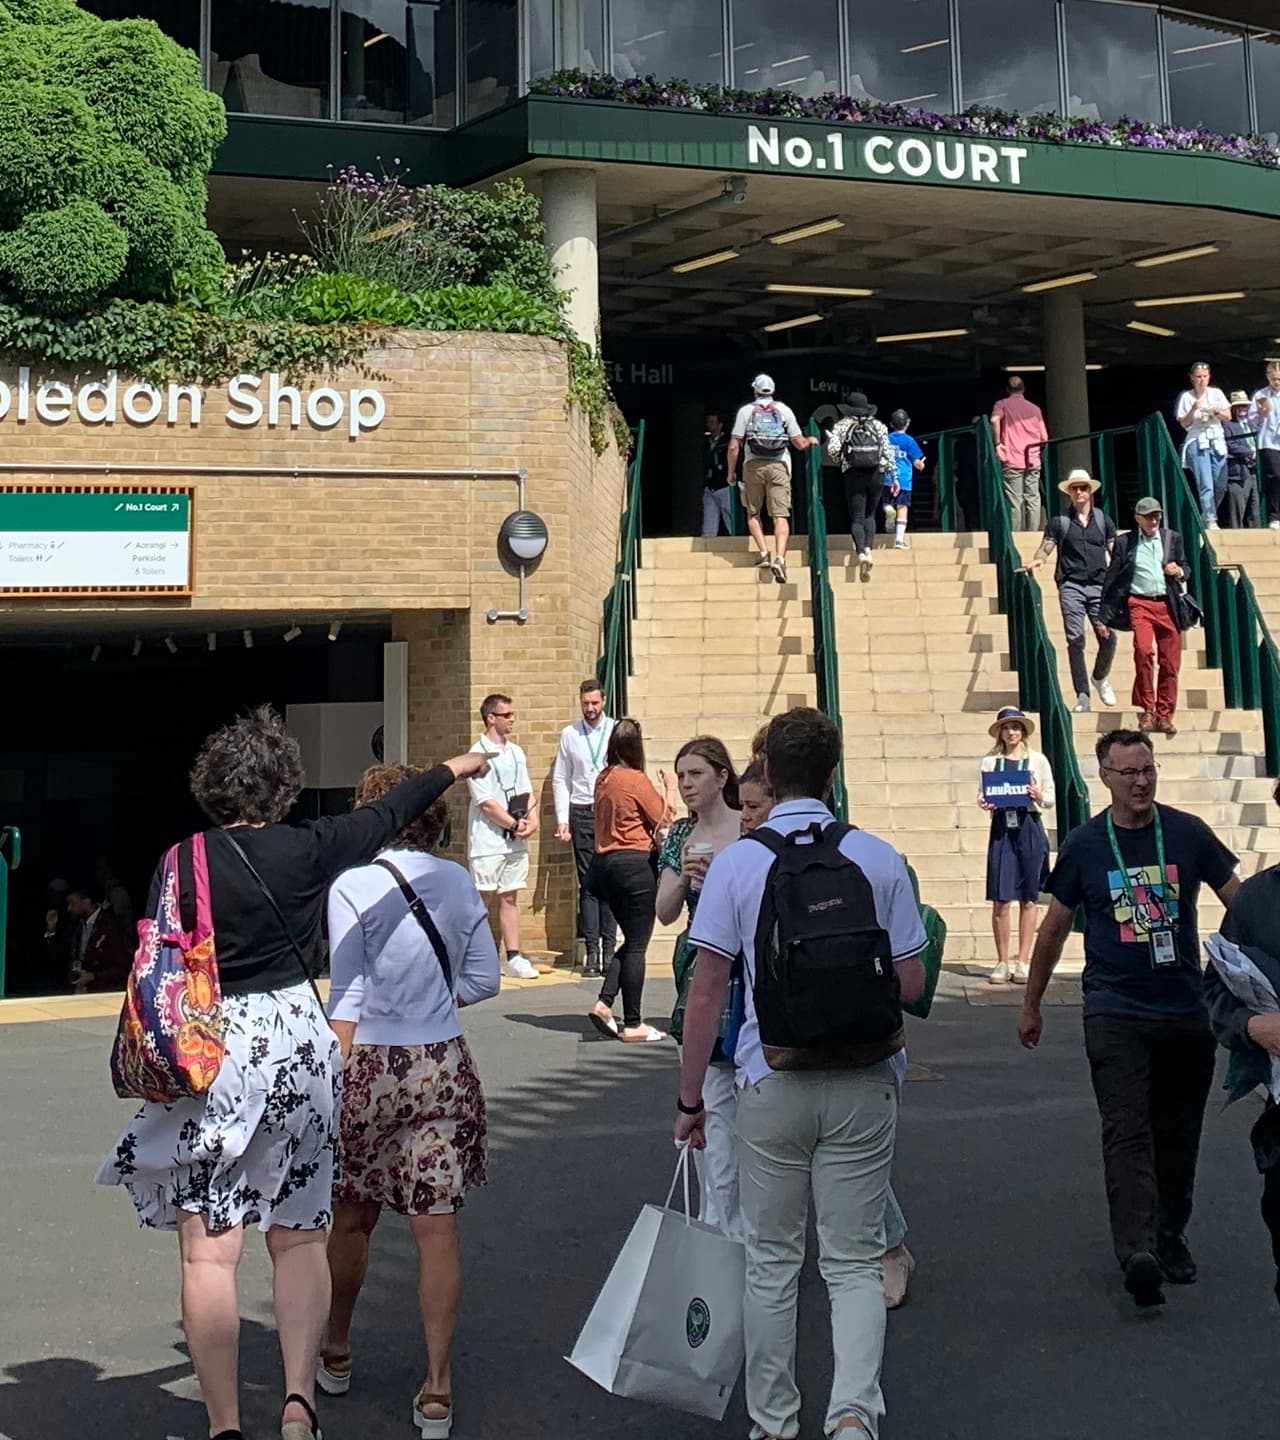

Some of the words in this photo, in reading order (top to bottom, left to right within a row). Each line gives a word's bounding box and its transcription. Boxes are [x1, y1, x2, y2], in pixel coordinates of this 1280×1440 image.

[748, 125, 844, 170] No.1
[864, 135, 1027, 184] COURT
[631, 363, 673, 384] Hall
[226, 372, 386, 437] Shop
[126, 503, 143, 512] No.1
[144, 504, 167, 512] Court
